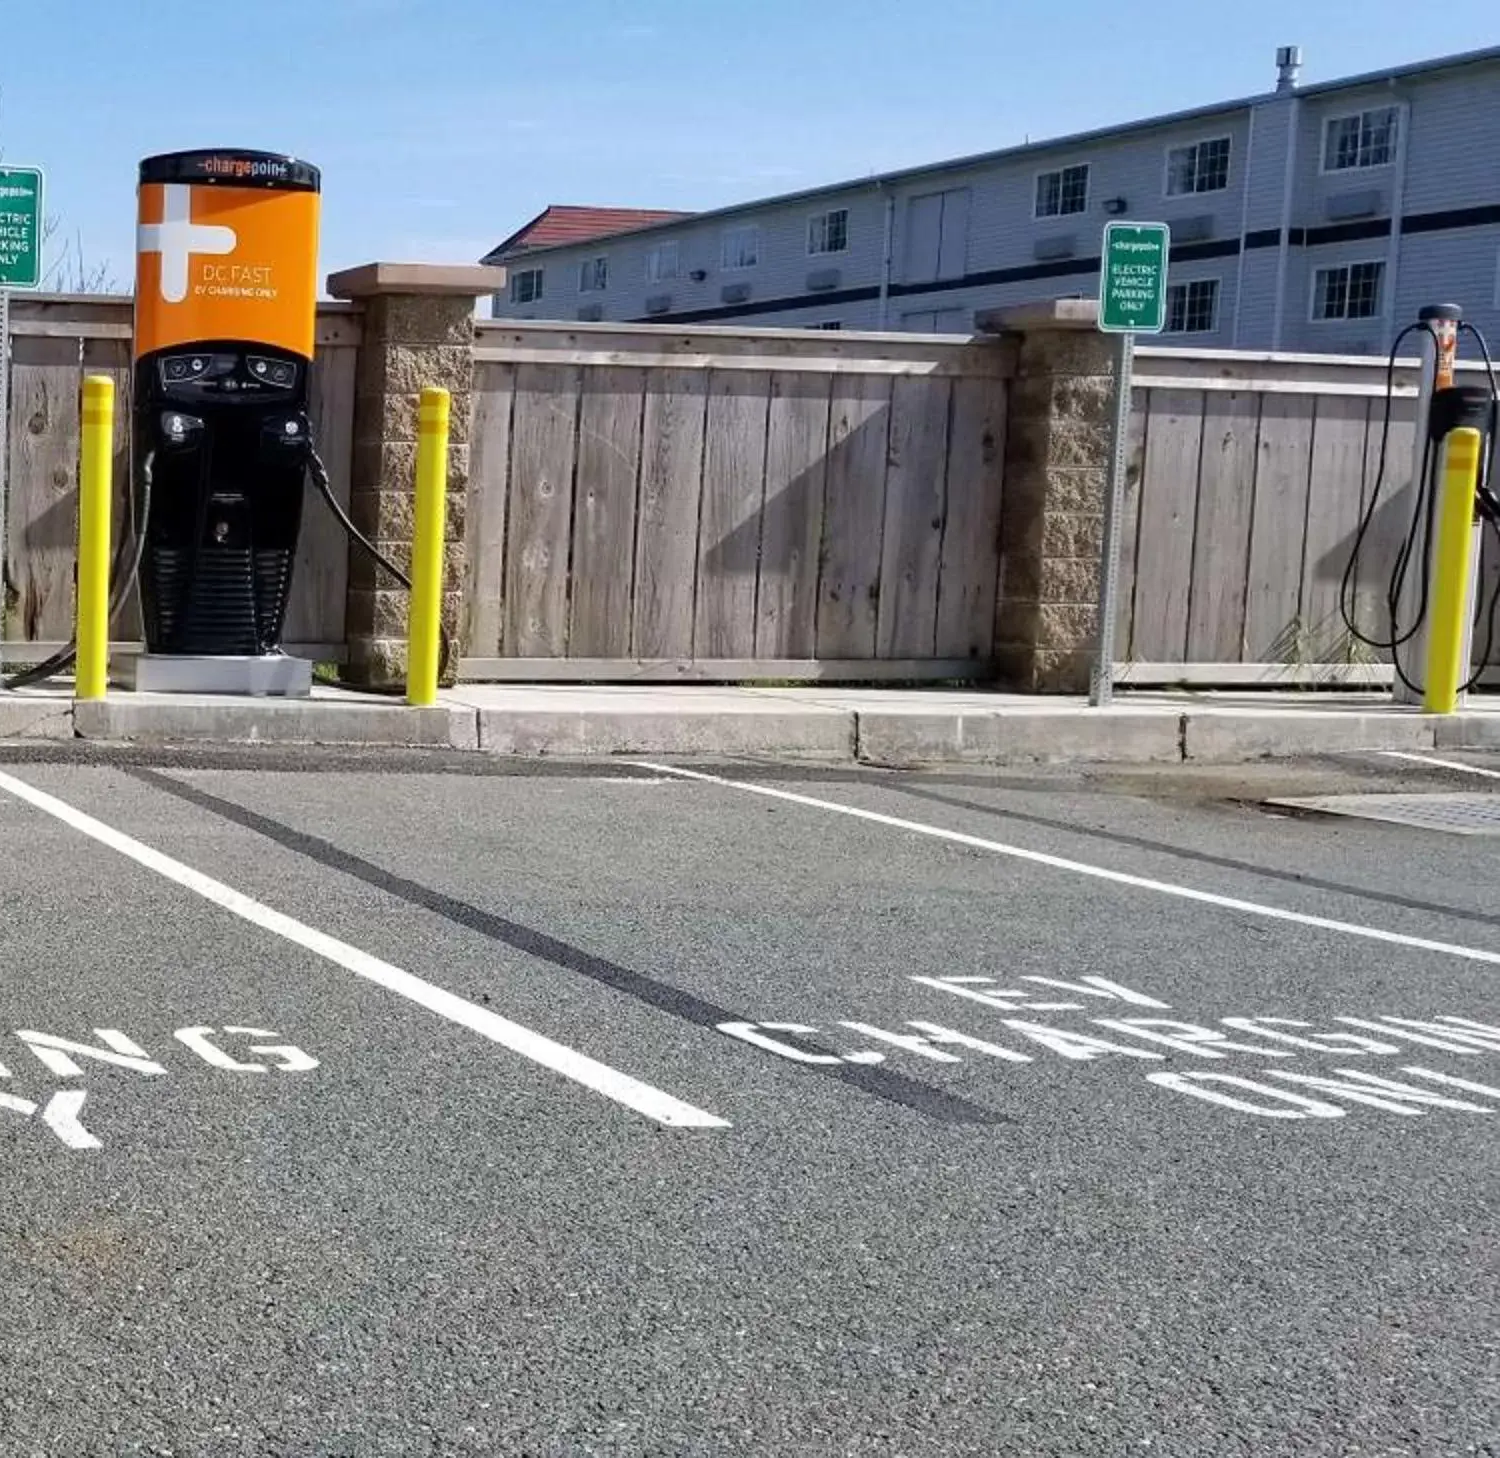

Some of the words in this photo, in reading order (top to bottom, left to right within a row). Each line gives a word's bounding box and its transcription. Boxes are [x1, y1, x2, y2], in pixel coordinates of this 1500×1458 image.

[203, 264, 227, 281] DC
[231, 265, 273, 285] FAST
[1111, 264, 1157, 275] ELECTRIC
[1114, 276, 1154, 287] VEHICLE
[1111, 288, 1155, 299] PARKING
[1119, 301, 1145, 311] ONLY
[906, 974, 1173, 1011] EV
